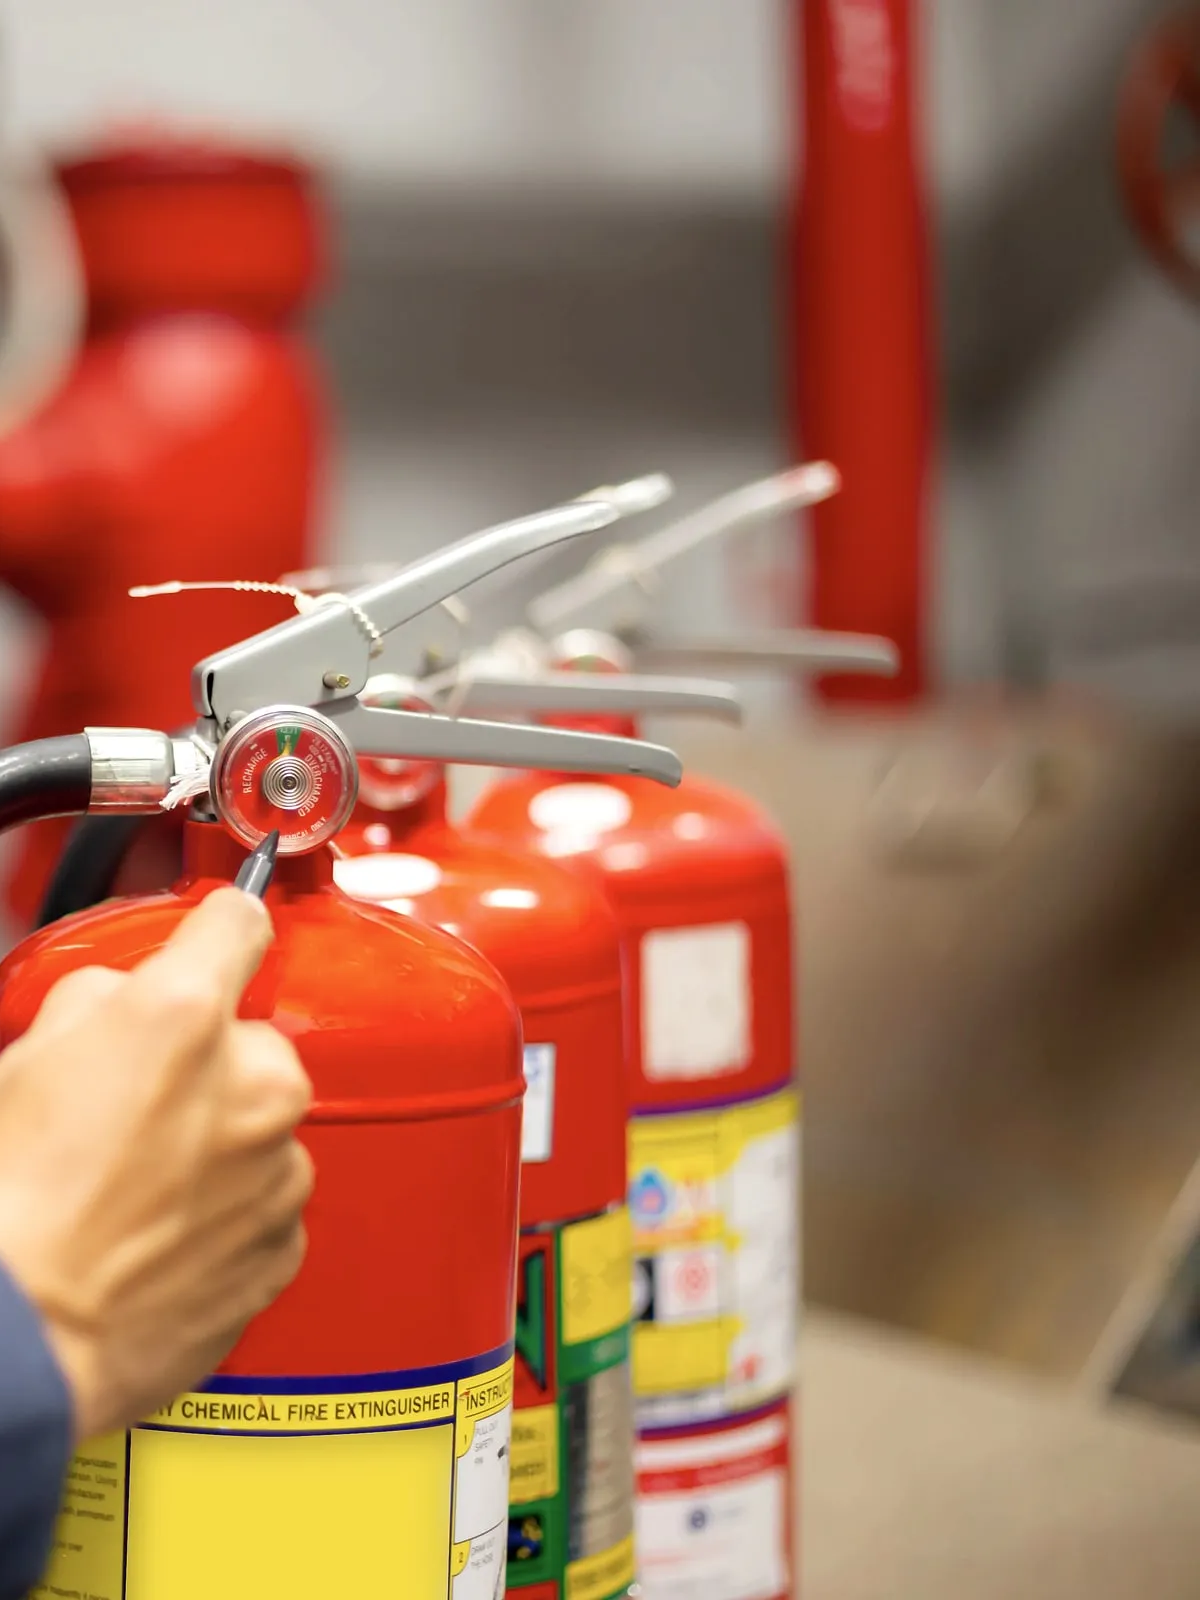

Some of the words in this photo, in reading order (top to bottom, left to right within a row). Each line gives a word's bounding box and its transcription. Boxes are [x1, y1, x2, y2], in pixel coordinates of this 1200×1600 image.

[243, 748, 269, 795] RECHARGE
[297, 754, 323, 818] OVERCHARGED
[311, 816, 327, 832] ONLY
[181, 1401, 281, 1421] CHEMICAL
[288, 1403, 328, 1421] FIRE
[335, 1391, 449, 1420] EXTINGUISHER
